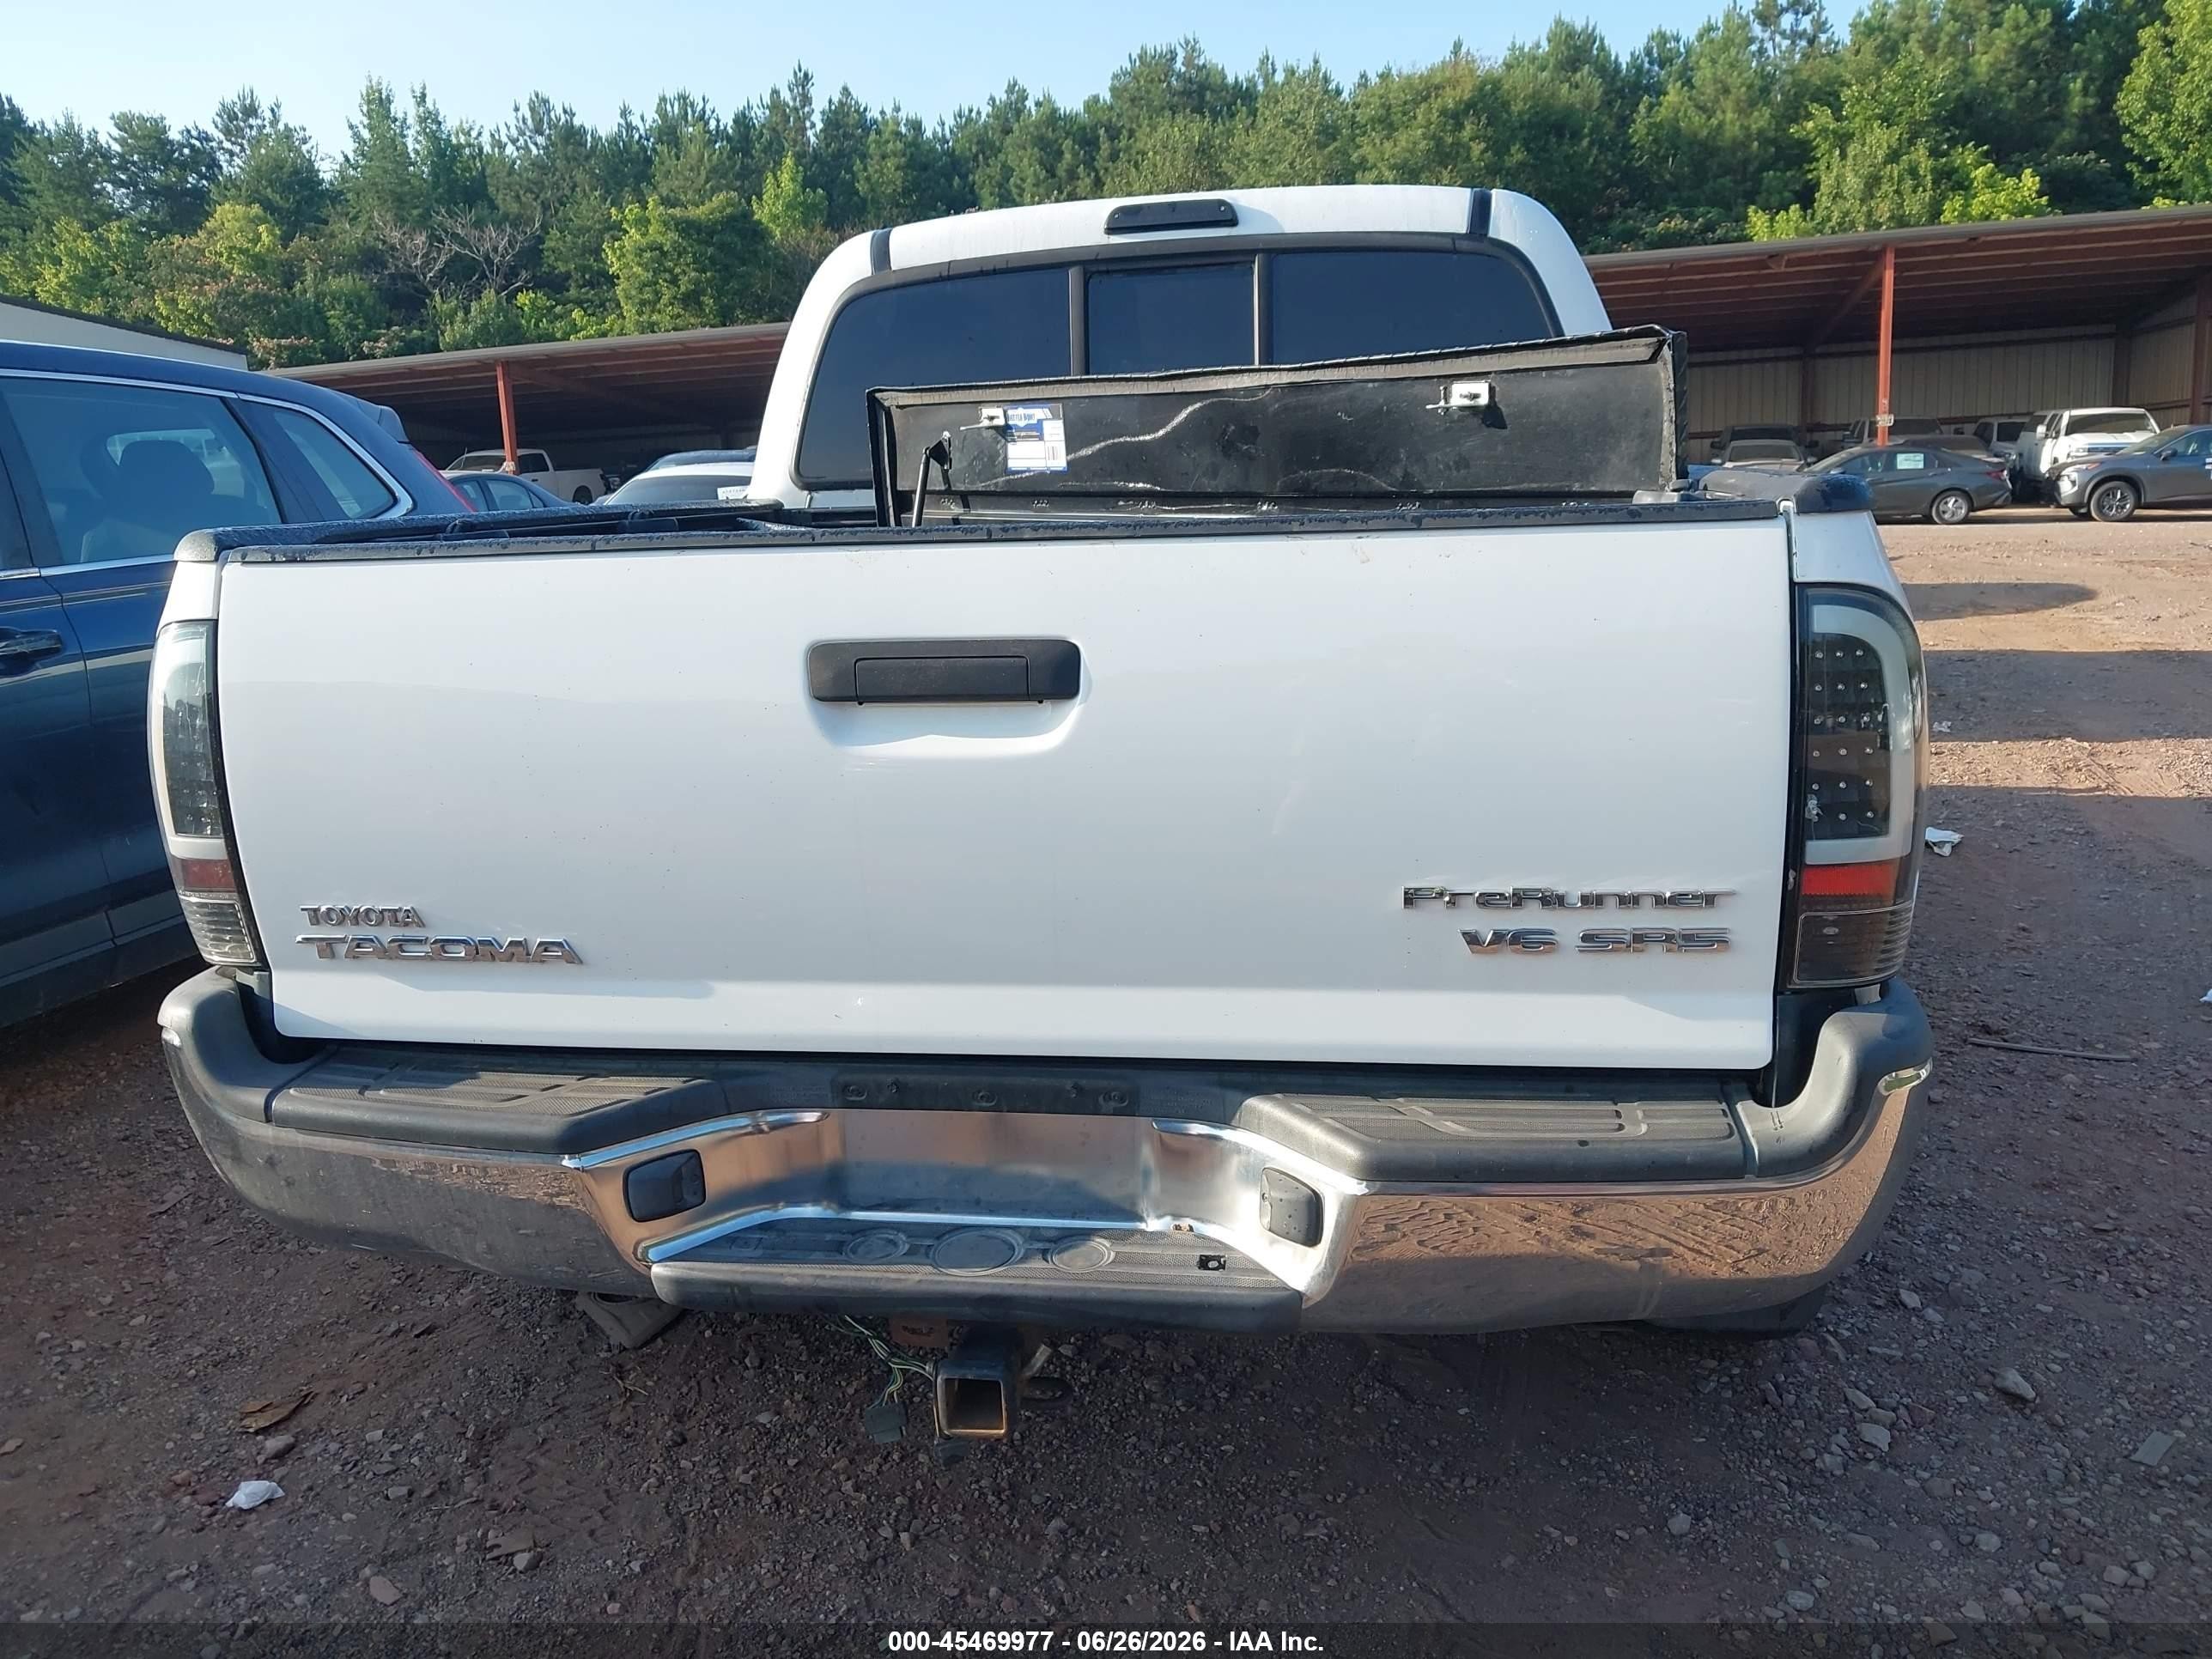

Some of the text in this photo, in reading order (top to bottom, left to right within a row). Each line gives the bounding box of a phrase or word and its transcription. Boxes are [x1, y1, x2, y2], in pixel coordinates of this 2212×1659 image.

[1401, 885, 1736, 909] PreRunner
[299, 905, 426, 927] TOYOTA
[295, 934, 584, 964] TACOMA
[1458, 927, 1731, 954] V6 SR5
